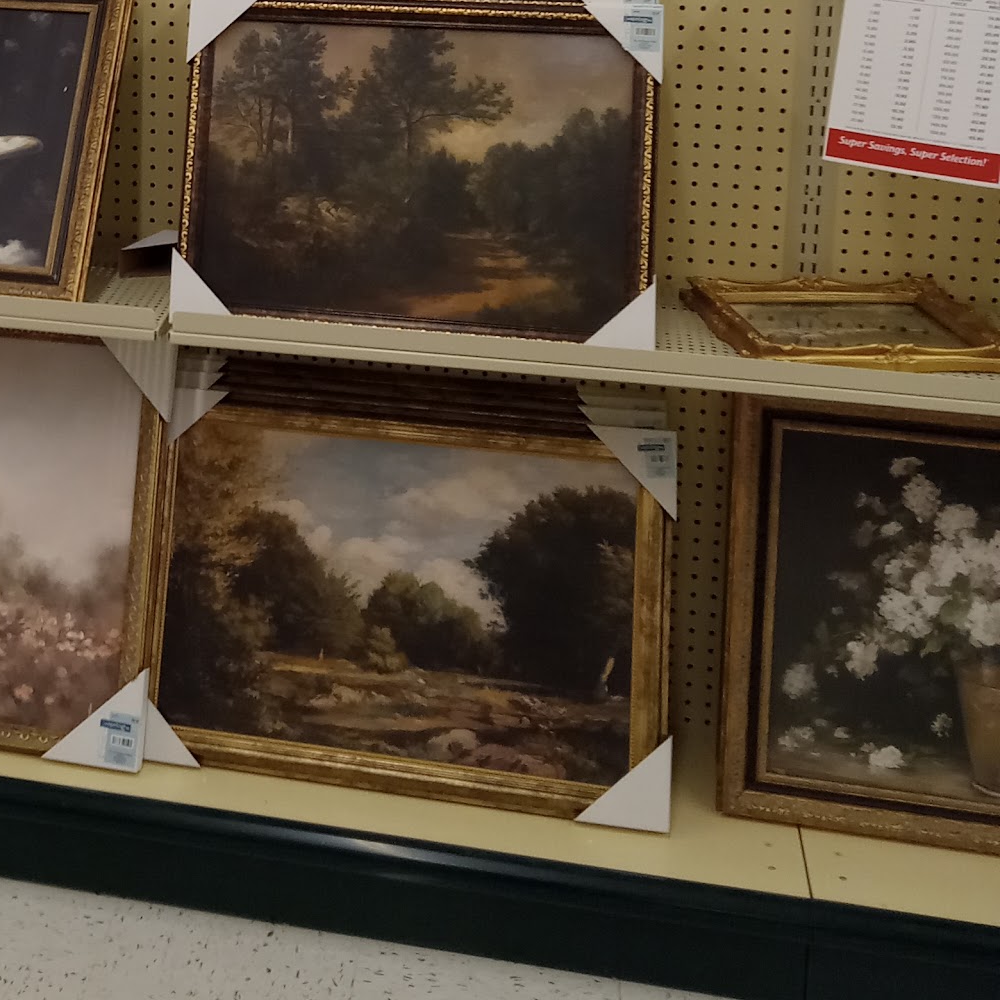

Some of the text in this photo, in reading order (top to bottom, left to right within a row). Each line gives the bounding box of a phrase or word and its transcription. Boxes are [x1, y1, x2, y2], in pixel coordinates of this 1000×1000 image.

[838, 135, 868, 148] Super
[868, 140, 907, 156] Savings,
[909, 147, 940, 160] Super
[939, 152, 988, 166] Selection!
